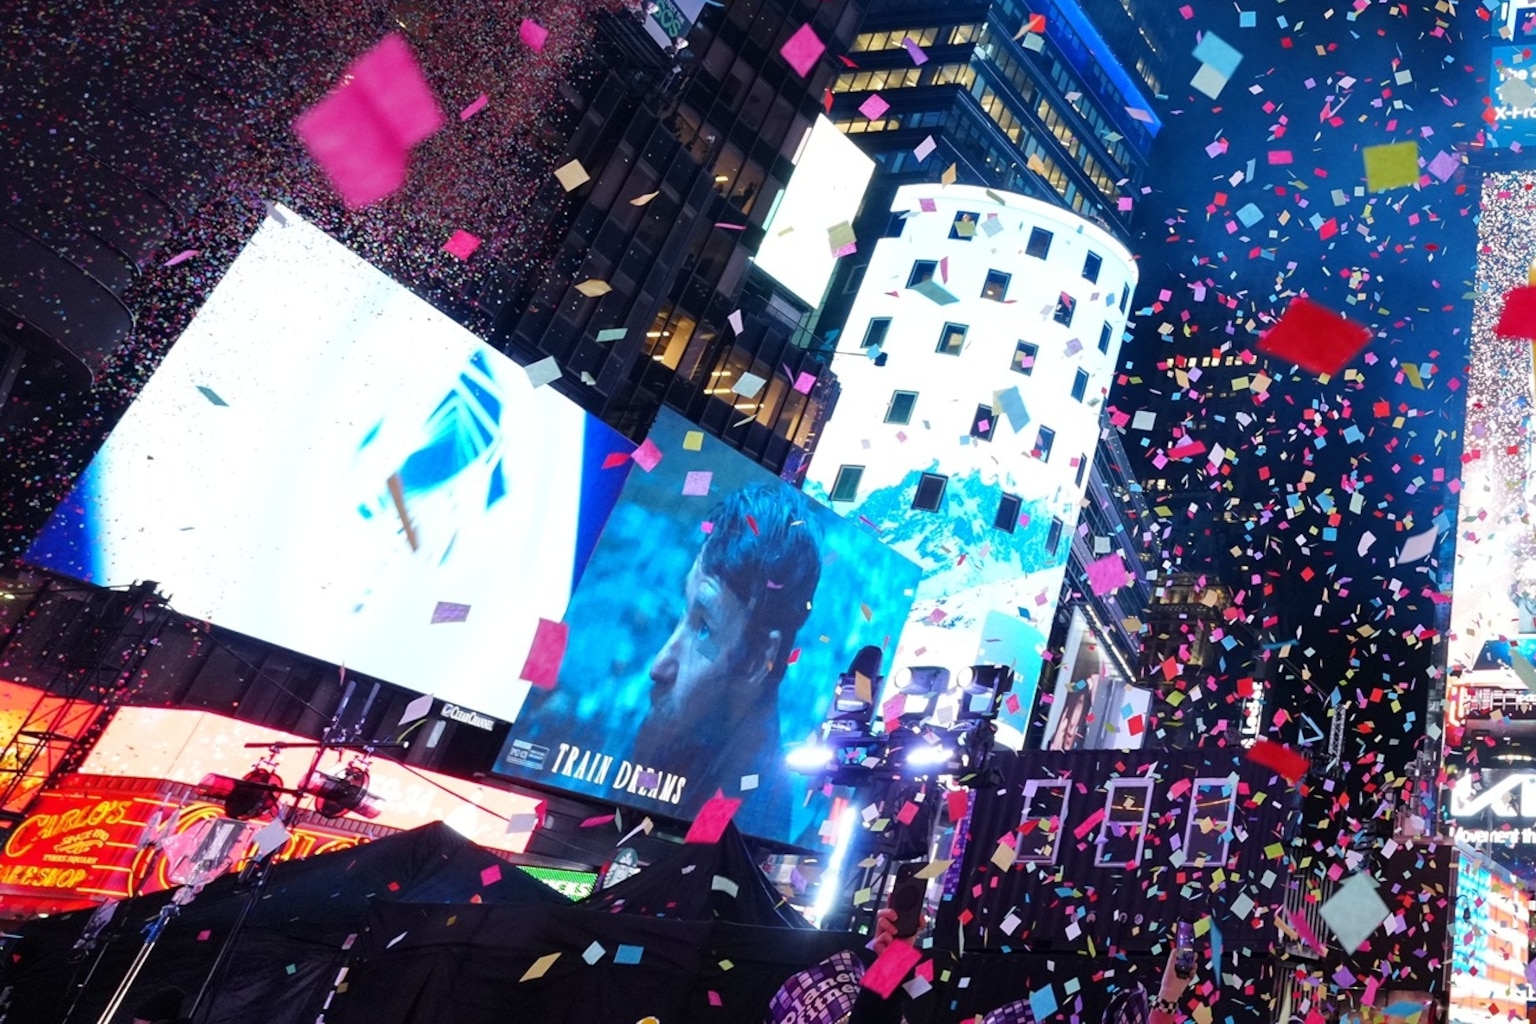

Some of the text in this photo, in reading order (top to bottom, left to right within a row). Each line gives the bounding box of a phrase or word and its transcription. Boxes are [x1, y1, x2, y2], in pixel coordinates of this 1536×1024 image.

[551, 742, 614, 785] TRAIN
[5, 800, 134, 858] CARLO'S
[779, 971, 859, 1024] planet
